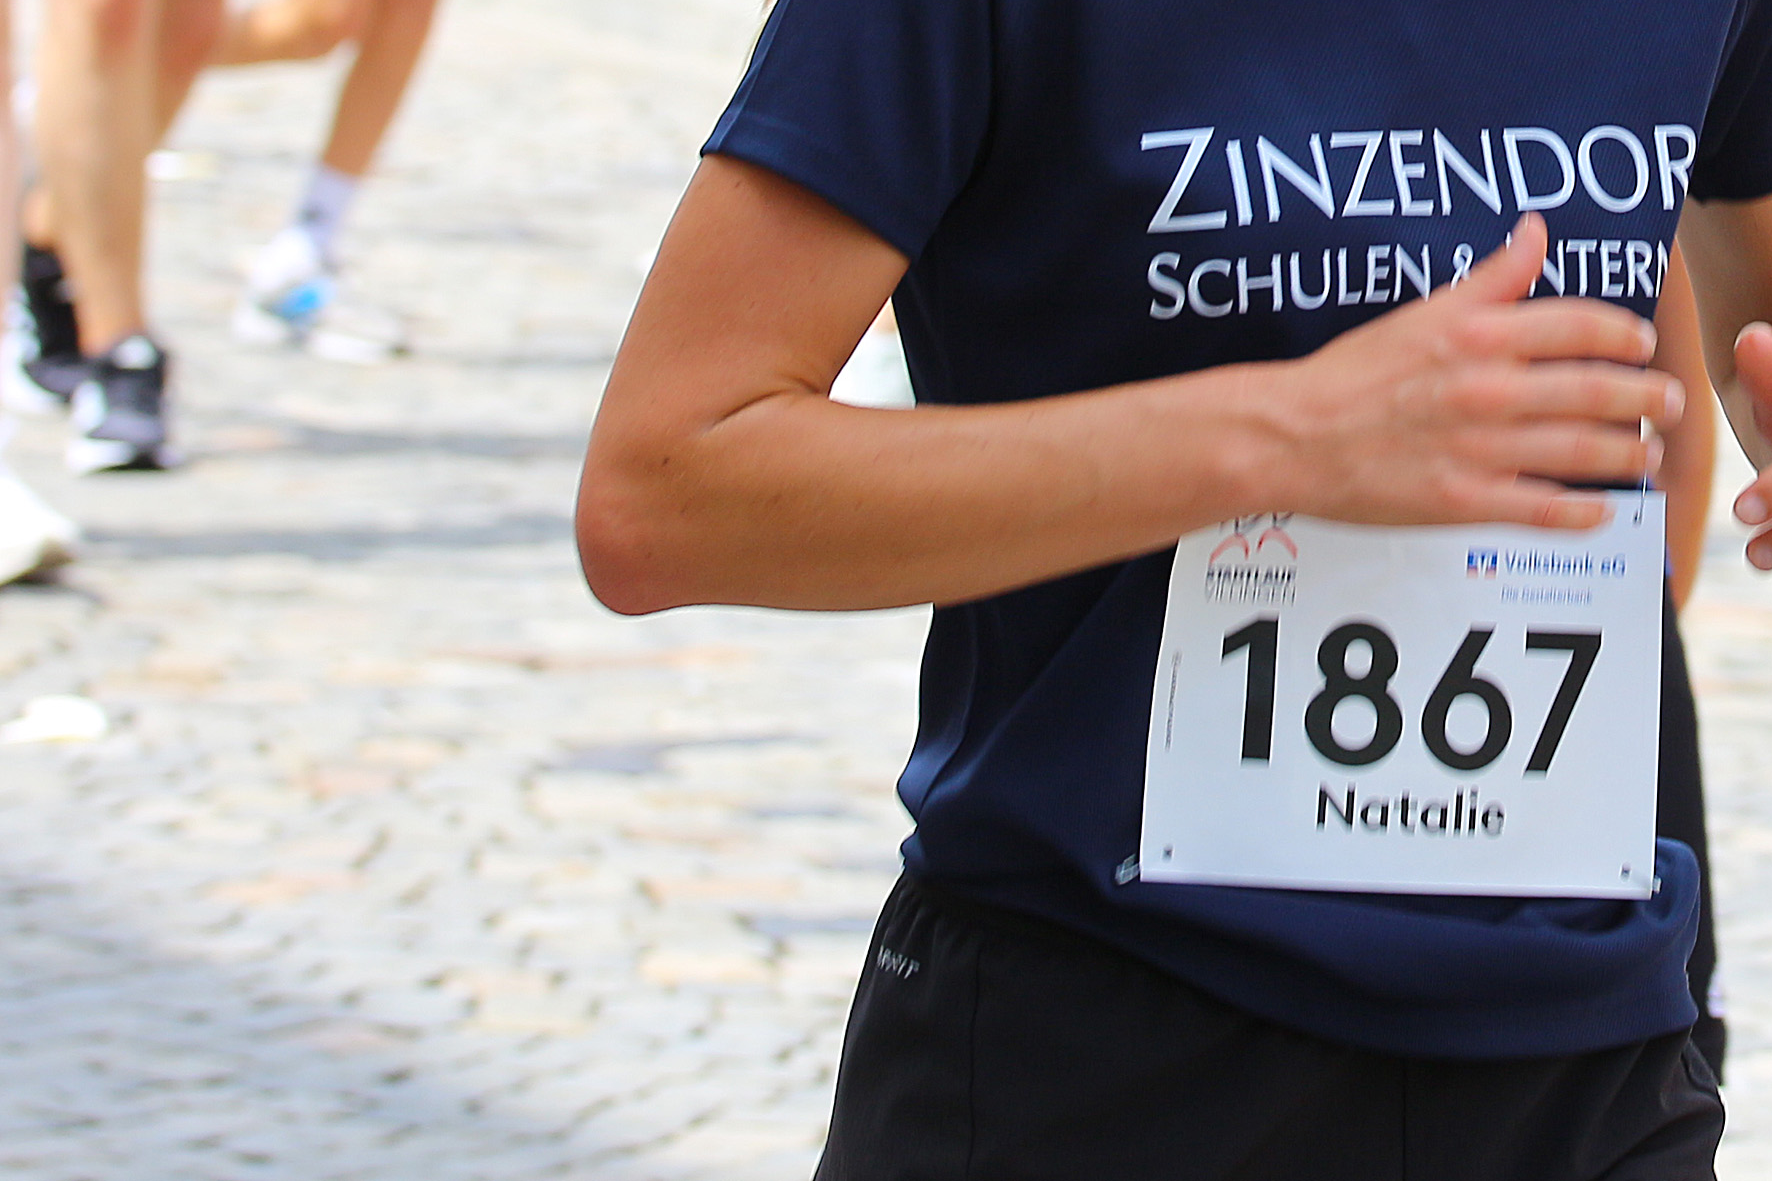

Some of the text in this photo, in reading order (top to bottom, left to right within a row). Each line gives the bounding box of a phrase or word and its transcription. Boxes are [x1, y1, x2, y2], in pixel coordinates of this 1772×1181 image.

[1140, 123, 1698, 234] ZINZENDOR
[1146, 242, 1432, 321] SCHULEN
[1504, 548, 1594, 577] Volksbank
[1219, 613, 1604, 779] 1867
[1314, 783, 1506, 837] Natalie
